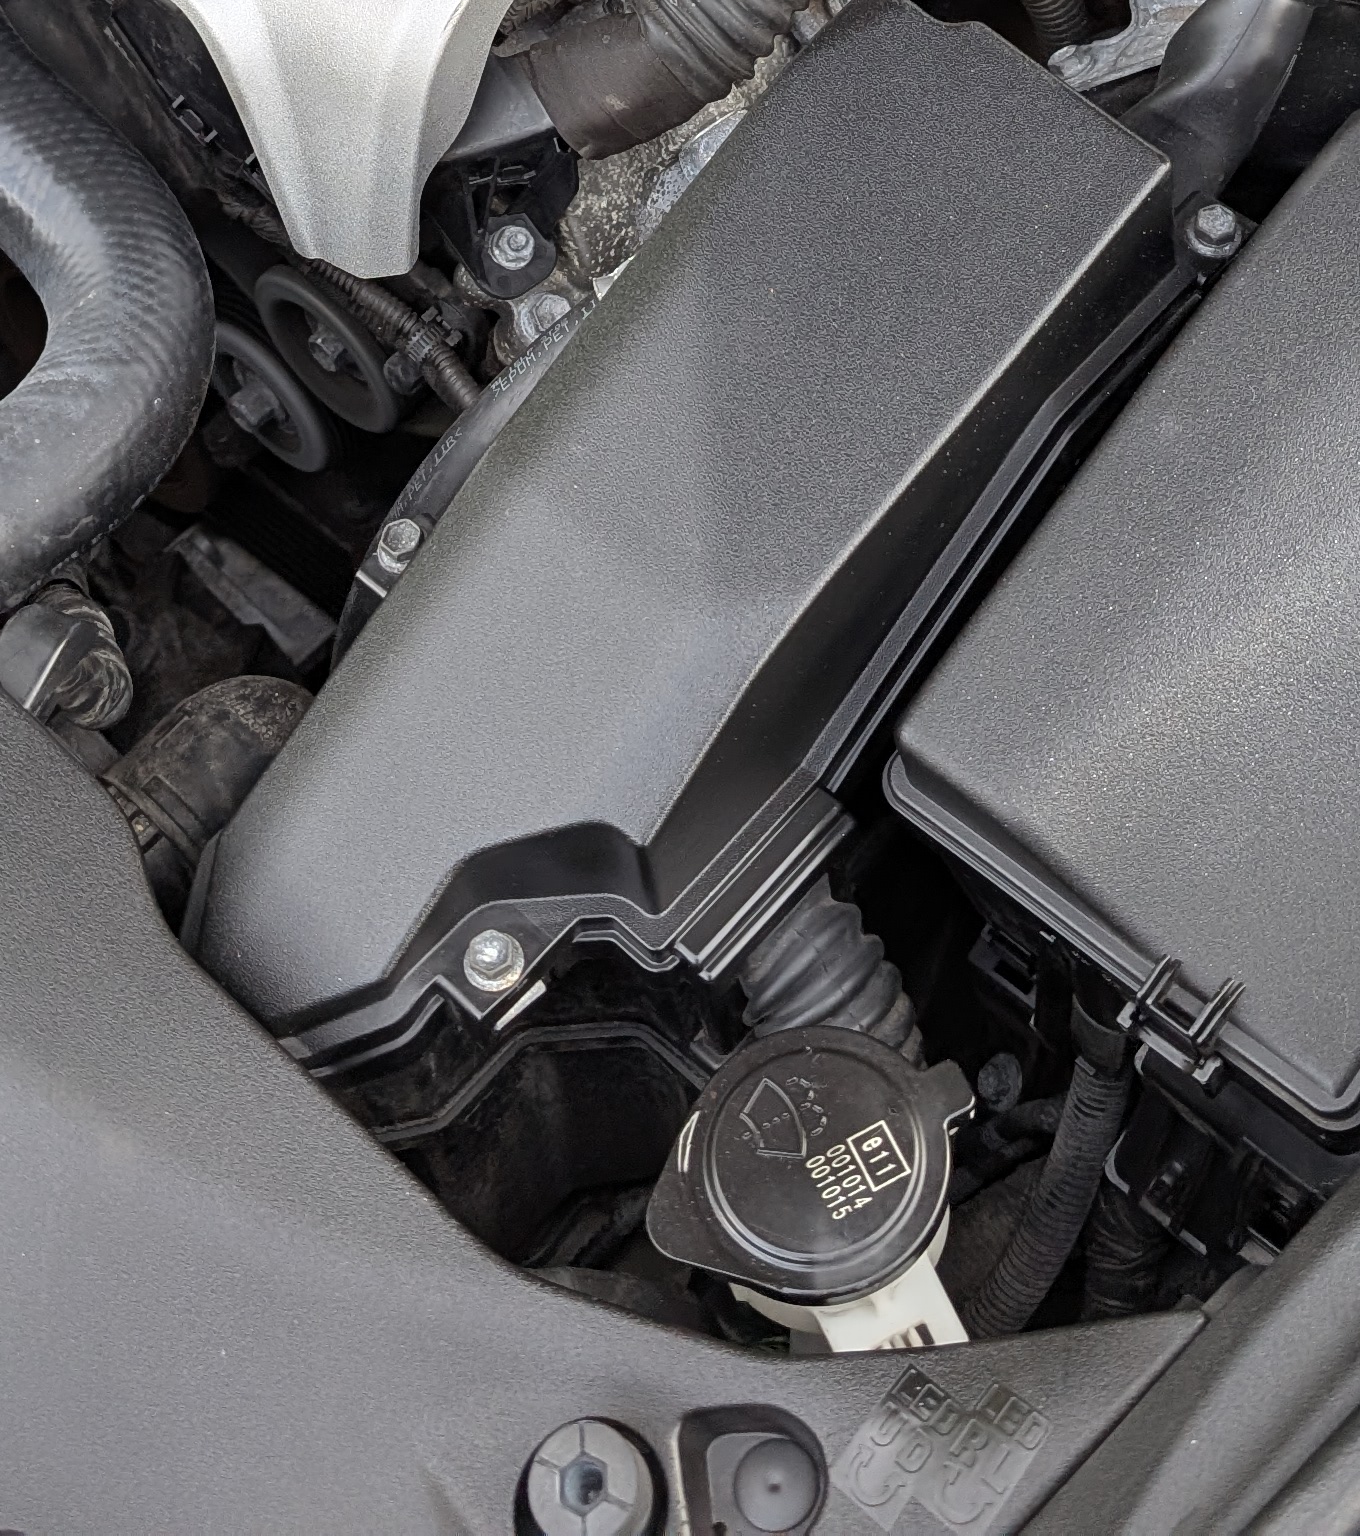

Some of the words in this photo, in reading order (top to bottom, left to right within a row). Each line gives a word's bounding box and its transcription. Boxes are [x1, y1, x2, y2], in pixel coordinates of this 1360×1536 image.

[804, 1155, 853, 1221] 001015
[826, 1144, 873, 1210] 001014
[861, 1135, 897, 1179] e11
[893, 1369, 962, 1436] LED
[976, 1383, 1050, 1451] LED
